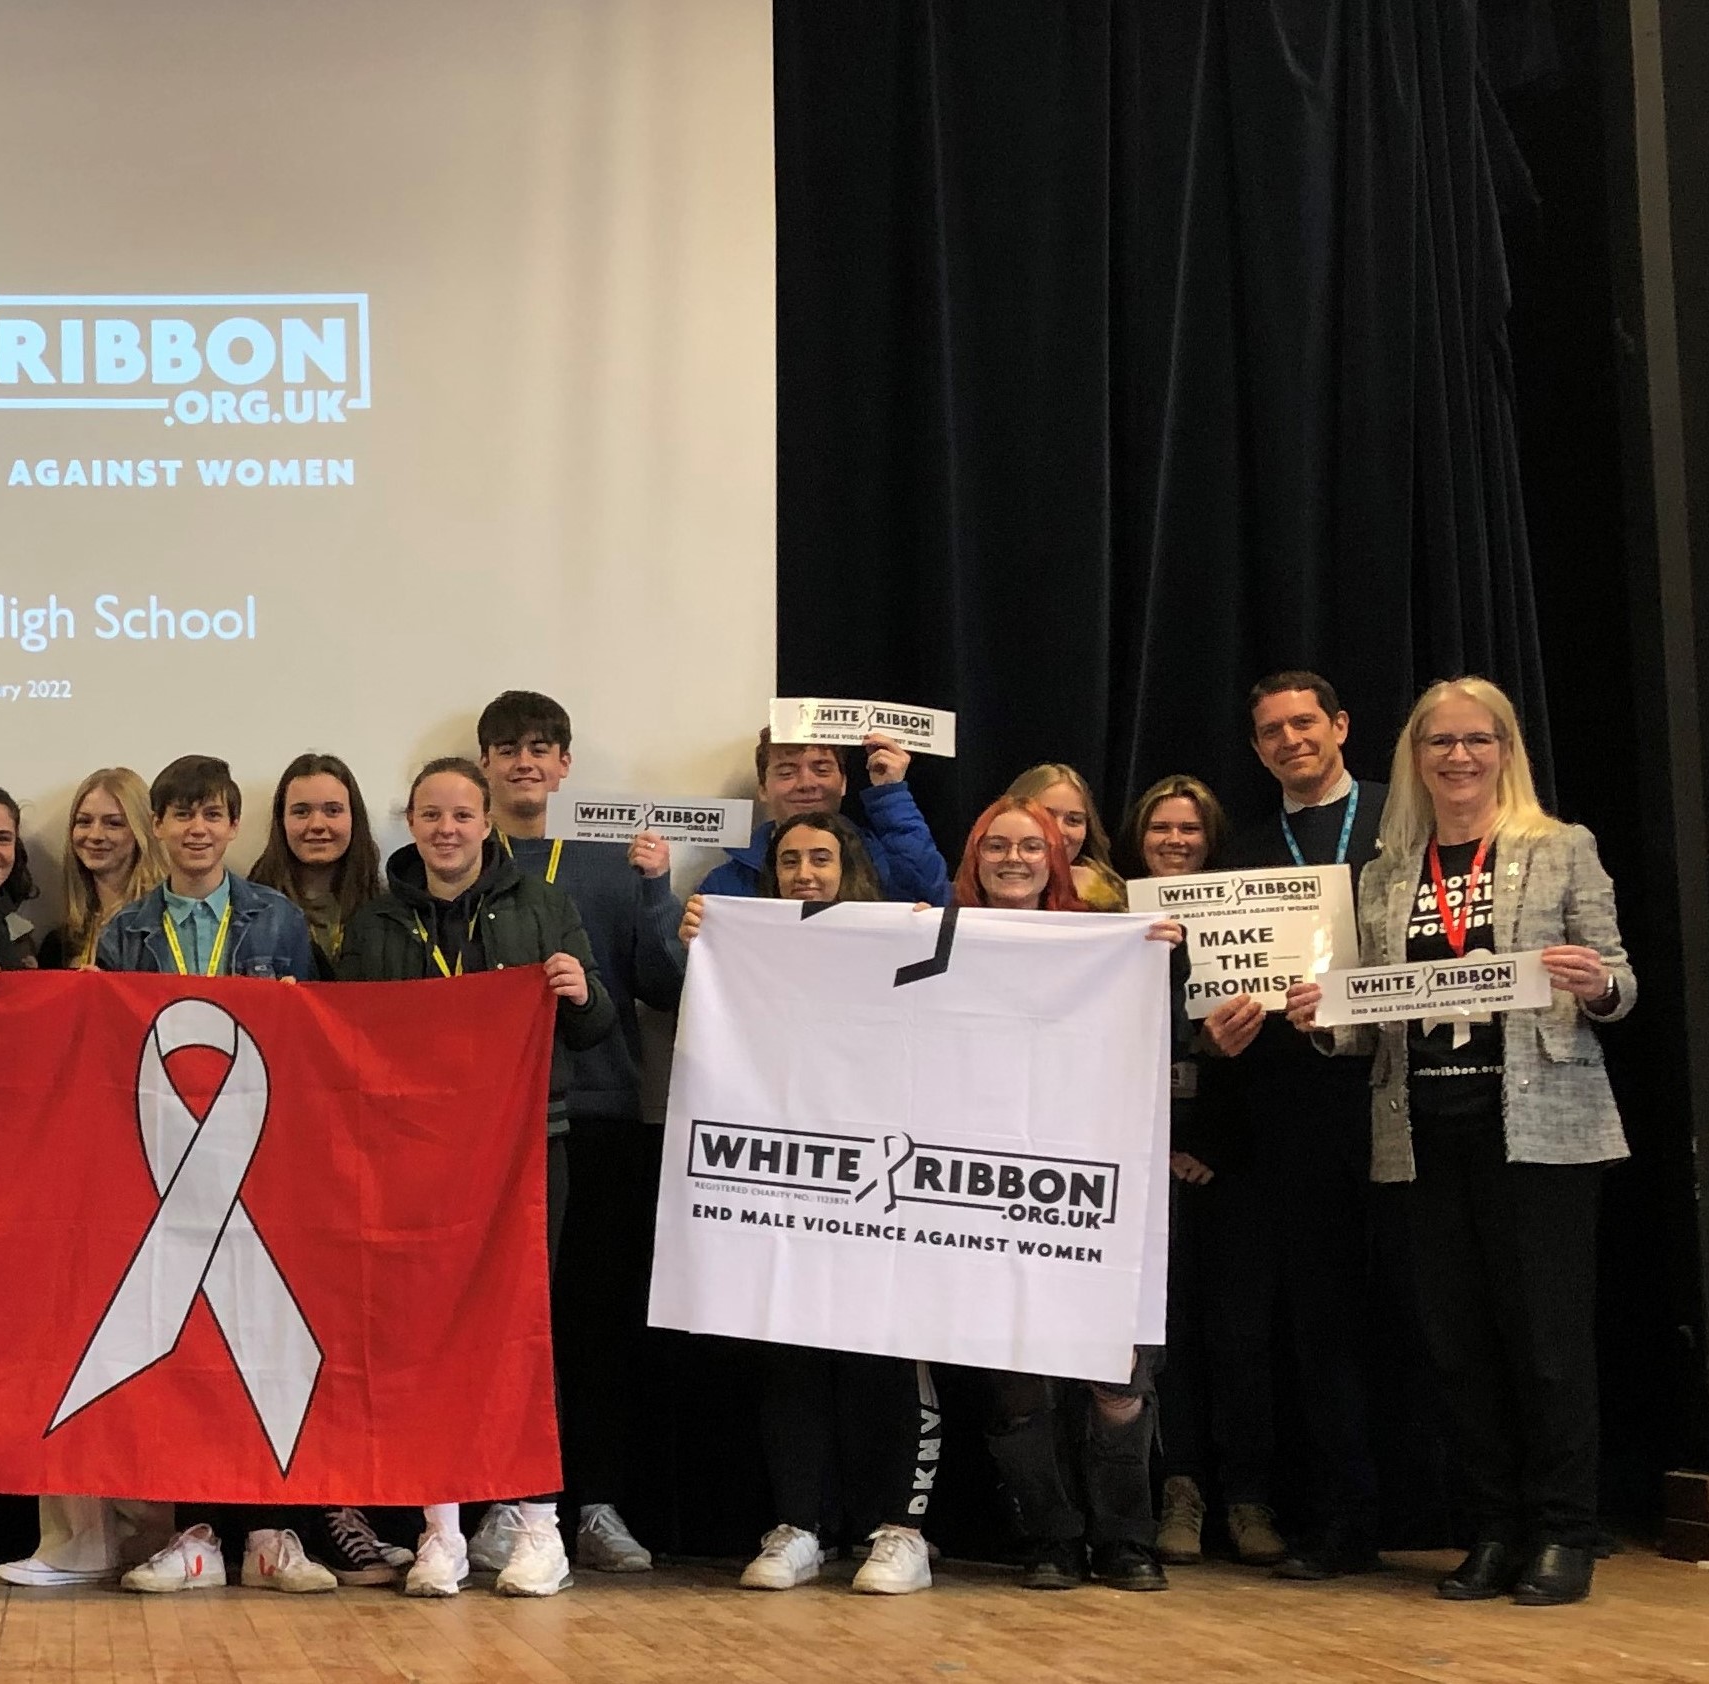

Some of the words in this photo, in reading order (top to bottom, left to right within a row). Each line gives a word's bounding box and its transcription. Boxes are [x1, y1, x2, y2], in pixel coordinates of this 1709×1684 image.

[164, 390, 346, 426] .ORG.UK
[8, 459, 182, 487] AGAINST
[197, 458, 356, 486] WOMEN
[95, 594, 257, 641] School
[27, 680, 72, 698] 2022
[876, 712, 931, 730] RIBBON
[579, 807, 636, 821] WHITE
[654, 810, 720, 825] RIBBON
[1163, 886, 1225, 902] WHITE
[1245, 880, 1316, 896] RIBBON
[1200, 927, 1274, 947] MAKE
[1217, 952, 1269, 970] THE
[1187, 975, 1304, 1000] PROMISE
[1351, 976, 1415, 994] WHITE
[1436, 966, 1511, 986] RIBBON
[700, 1132, 861, 1183] WHITE
[914, 1156, 1105, 1209] RIBBON
[694, 1181, 748, 1195] REGISTERED
[751, 1187, 791, 1199] CHARITY
[1001, 1203, 1102, 1230] .ORG.UK
[692, 1203, 732, 1221] END
[740, 1209, 795, 1229] MALE
[803, 1217, 906, 1242] VIOLENCE
[914, 1229, 1009, 1253] AGAINST
[1017, 1240, 1102, 1263] WOMEN
[907, 1408, 941, 1515] DKNY
